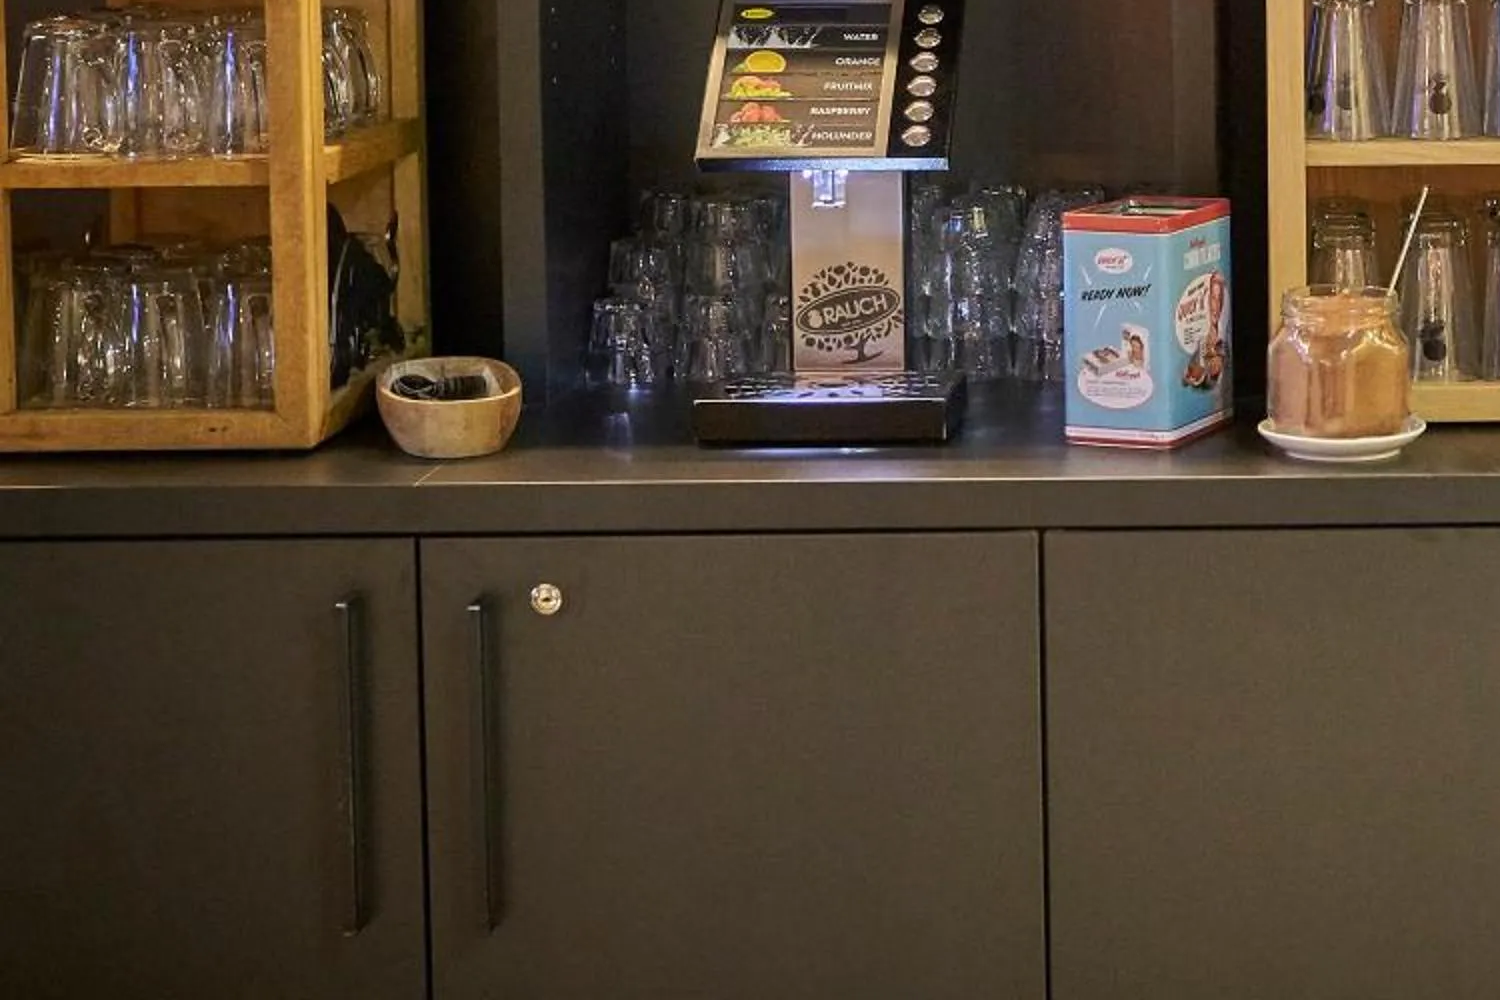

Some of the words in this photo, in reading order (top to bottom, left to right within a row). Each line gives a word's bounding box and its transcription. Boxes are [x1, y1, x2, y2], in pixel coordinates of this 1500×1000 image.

[843, 32, 879, 41] WATER
[835, 56, 881, 66] ORANGE
[810, 106, 871, 116] RASPBERRY
[811, 131, 873, 141] HOLUNDER
[823, 293, 888, 324] RAUCH
